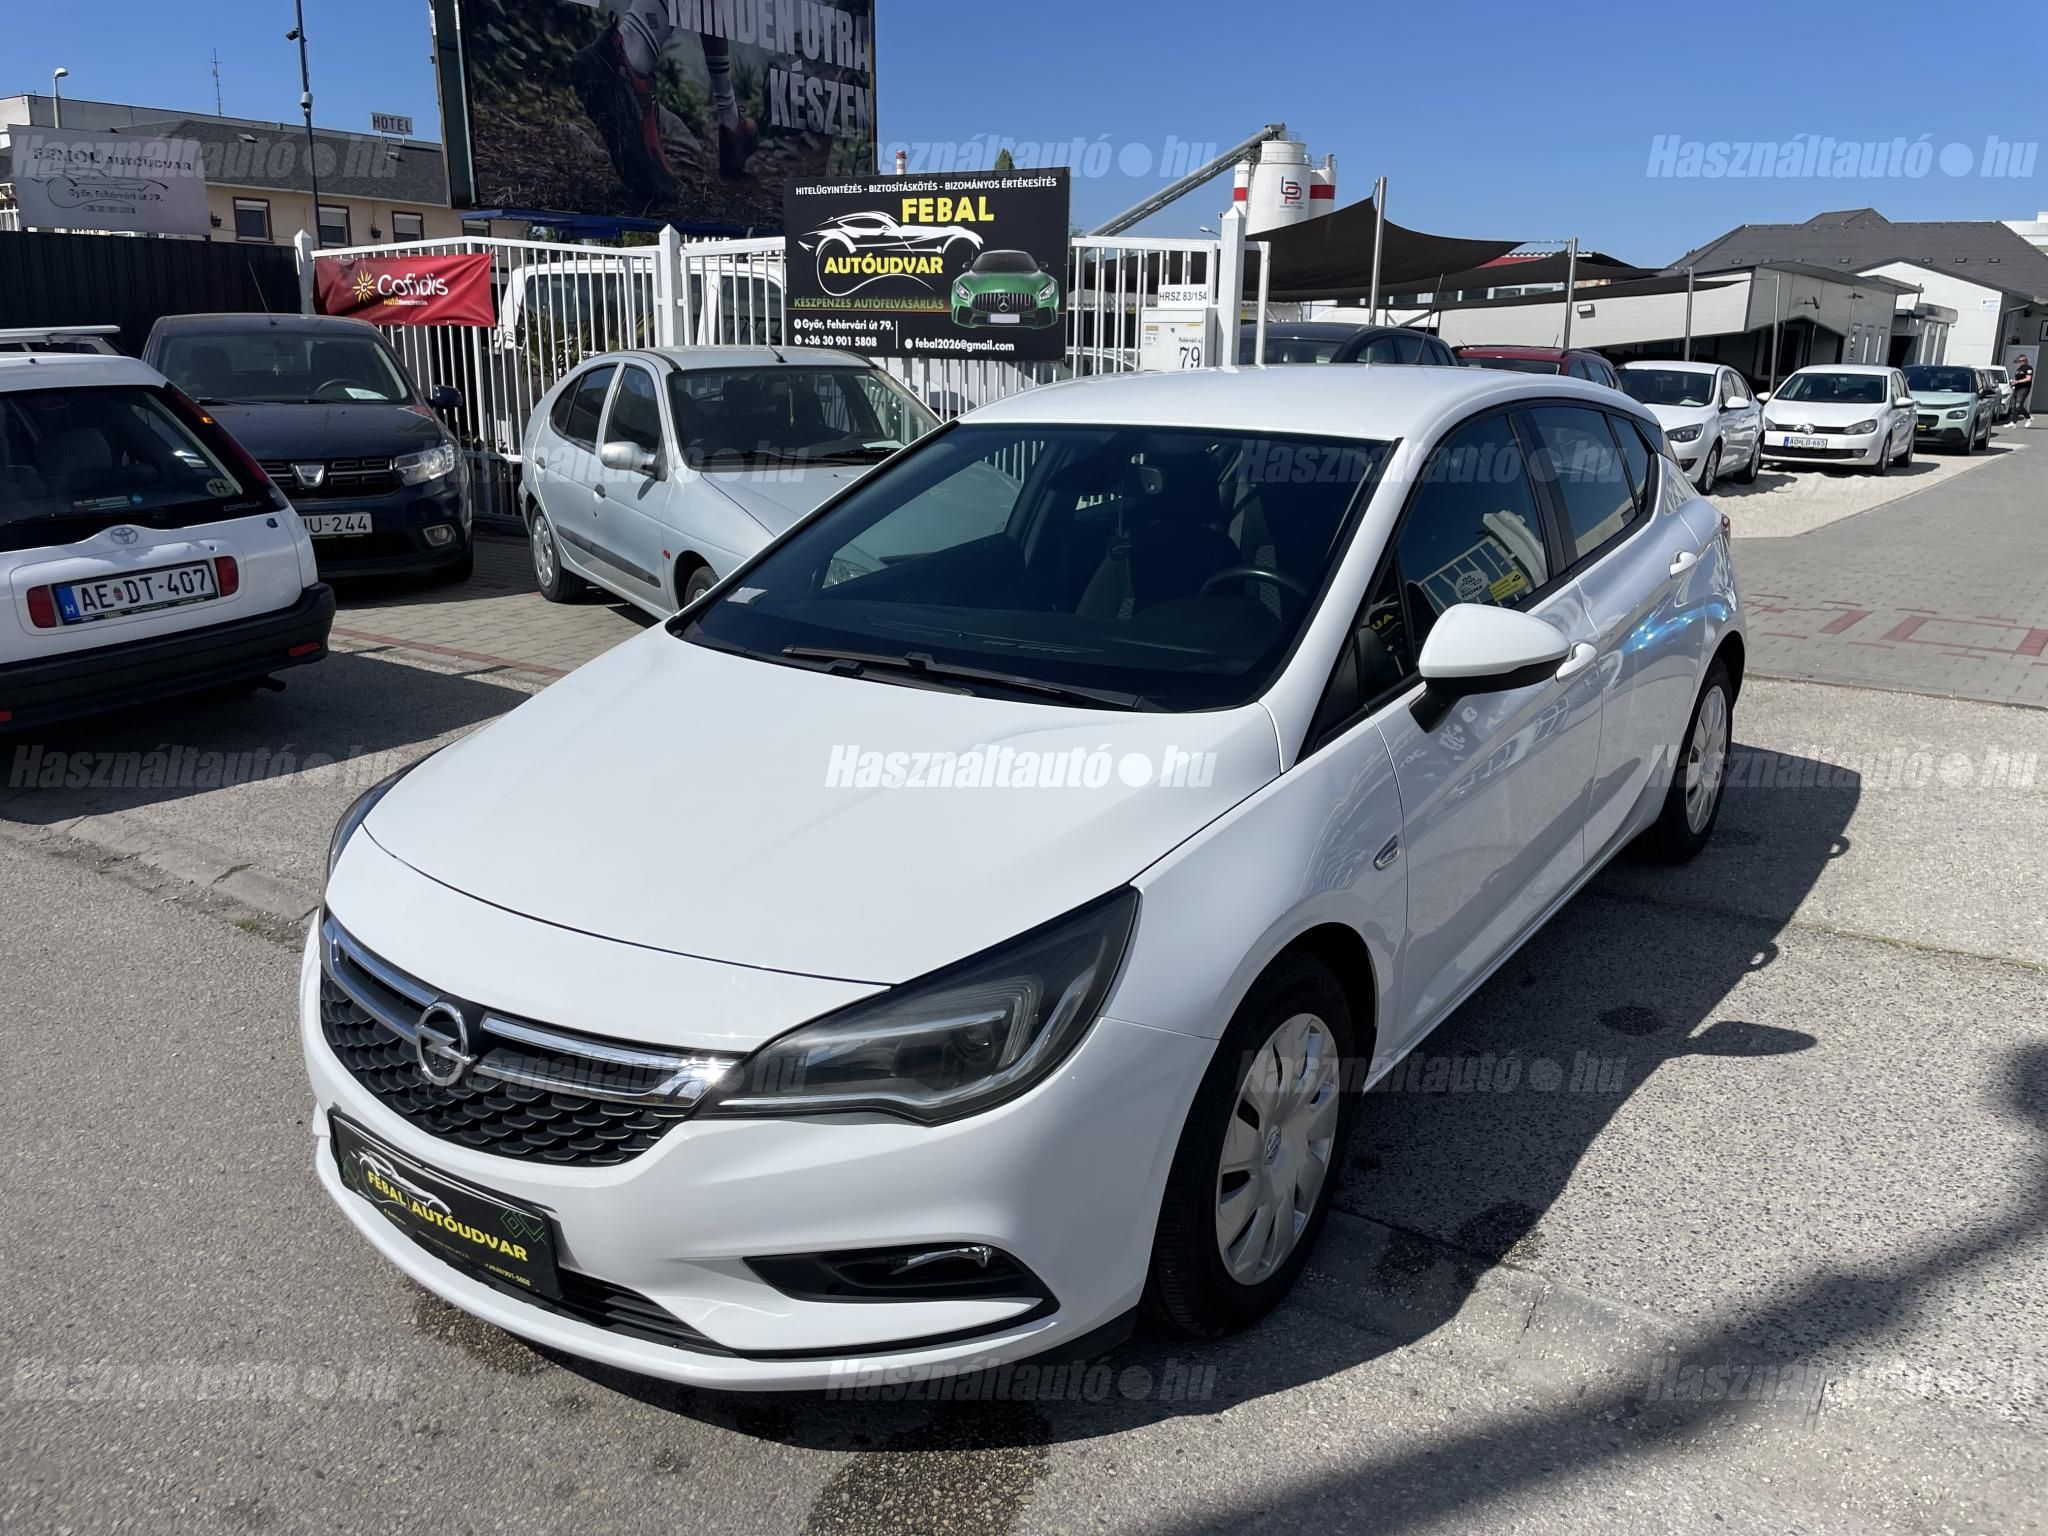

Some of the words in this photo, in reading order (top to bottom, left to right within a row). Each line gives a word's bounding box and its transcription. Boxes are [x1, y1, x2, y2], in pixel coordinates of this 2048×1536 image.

[769, 59, 871, 138] KÉSZEN
[372, 114, 412, 134] HOTEL
[795, 183, 863, 195] HITELÜGYINTÉZÉS
[868, 180, 938, 193] BIZTOSÍTÁSKÖTÉS
[945, 178, 1000, 190] BIZOMÁNYOS
[1001, 176, 1057, 188] ÉRTÉKESÍTÉS
[901, 196, 995, 223] FEBAL
[824, 252, 944, 274] AUTÓUDVAR
[377, 273, 448, 296] Cofidis
[794, 295, 851, 309] KÉSZPÉNZES
[854, 296, 944, 310] AUTÓFELVÁSÁRLÁS
[1159, 291, 1181, 301] HRSZ
[1182, 291, 1207, 301] 83/154
[802, 320, 825, 331] Győr,
[827, 319, 867, 330] Fehérvári
[868, 320, 878, 331] út
[804, 336, 820, 346] +36
[821, 336, 834, 346] 30
[835, 336, 852, 346] 901
[854, 336, 877, 347] 5808
[914, 338, 1015, 352] febal2026@gmail.com
[1180, 346, 1200, 369] 79
[216, 481, 226, 493] H
[65, 604, 75, 616] H
[367, 1170, 407, 1207] FEBAL
[411, 1199, 529, 1262] AUTÓUDVAR
